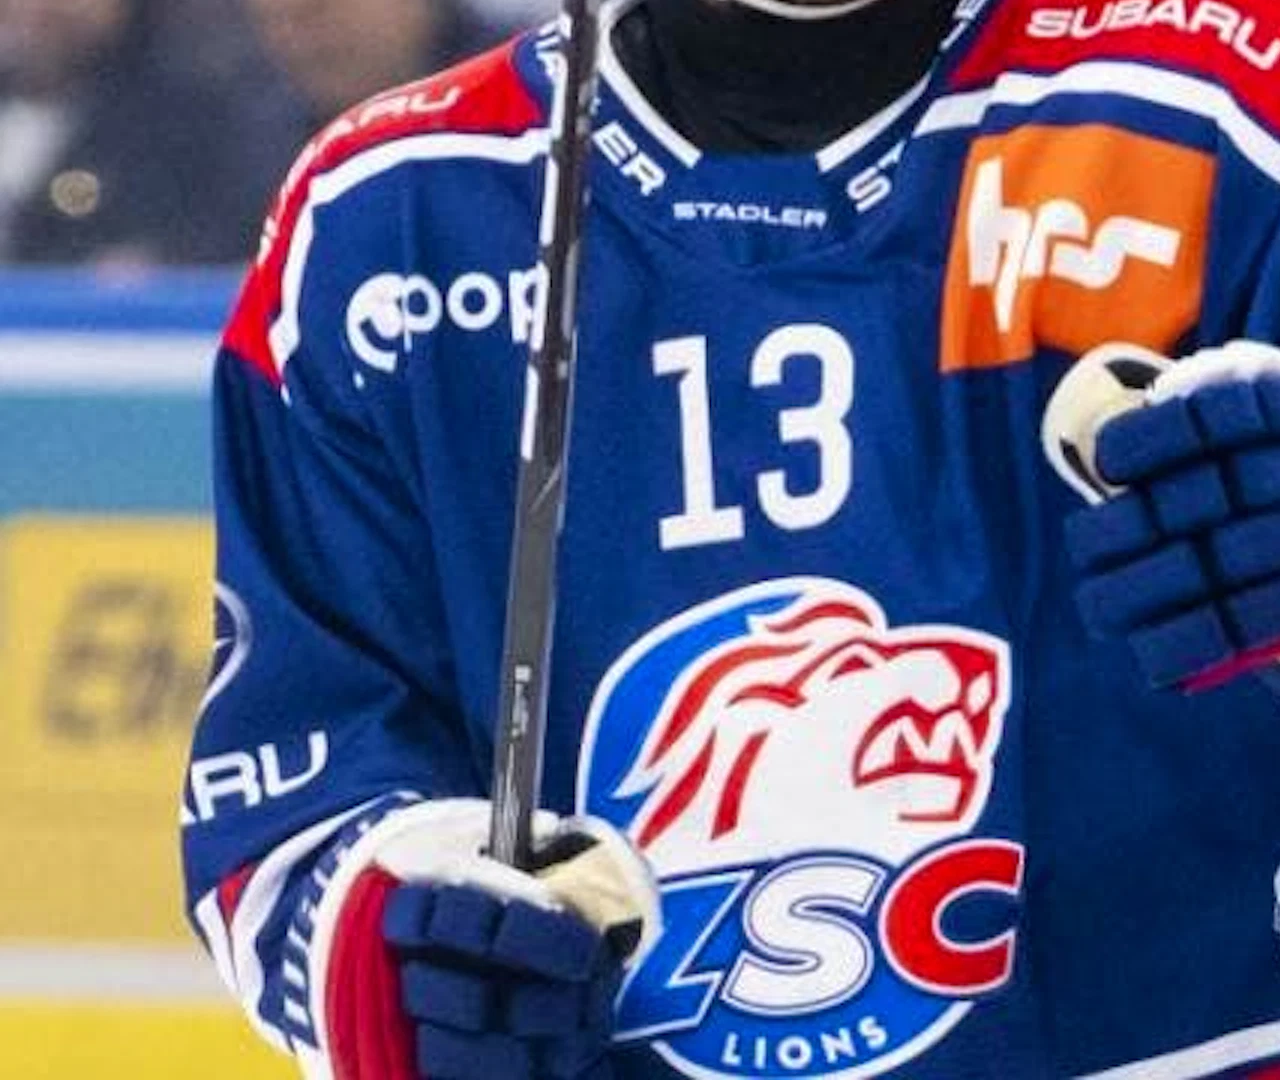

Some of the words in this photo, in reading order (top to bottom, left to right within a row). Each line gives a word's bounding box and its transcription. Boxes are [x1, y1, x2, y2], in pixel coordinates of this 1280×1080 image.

[672, 201, 828, 230] STADLER
[652, 324, 854, 550] 13
[612, 837, 1026, 1042] ZSC
[722, 1016, 888, 1070] LIONS
